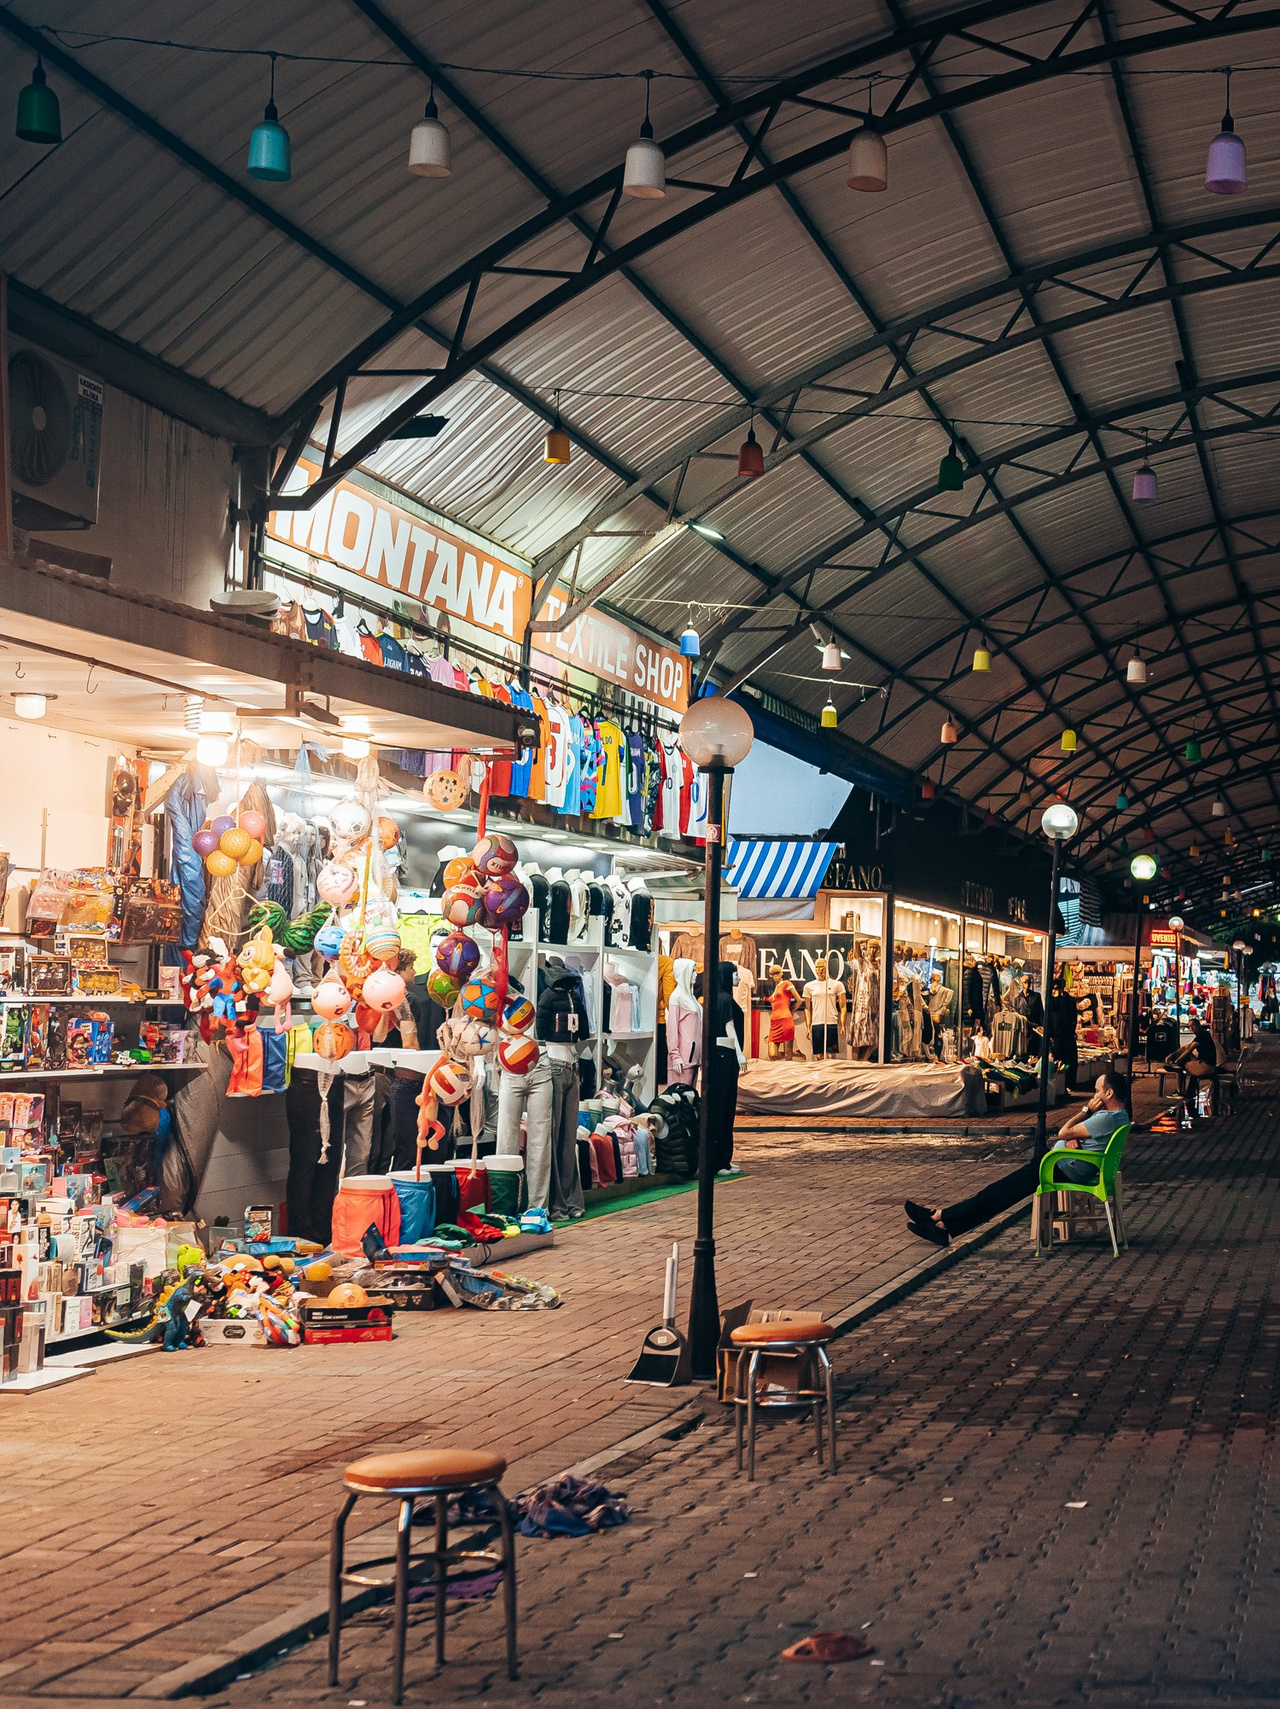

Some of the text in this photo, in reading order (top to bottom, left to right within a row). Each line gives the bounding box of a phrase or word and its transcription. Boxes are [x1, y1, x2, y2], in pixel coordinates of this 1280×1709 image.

[274, 465, 517, 638] MONTANA
[545, 594, 684, 702] TEXTILE SHOP
[757, 947, 845, 982] FANO
